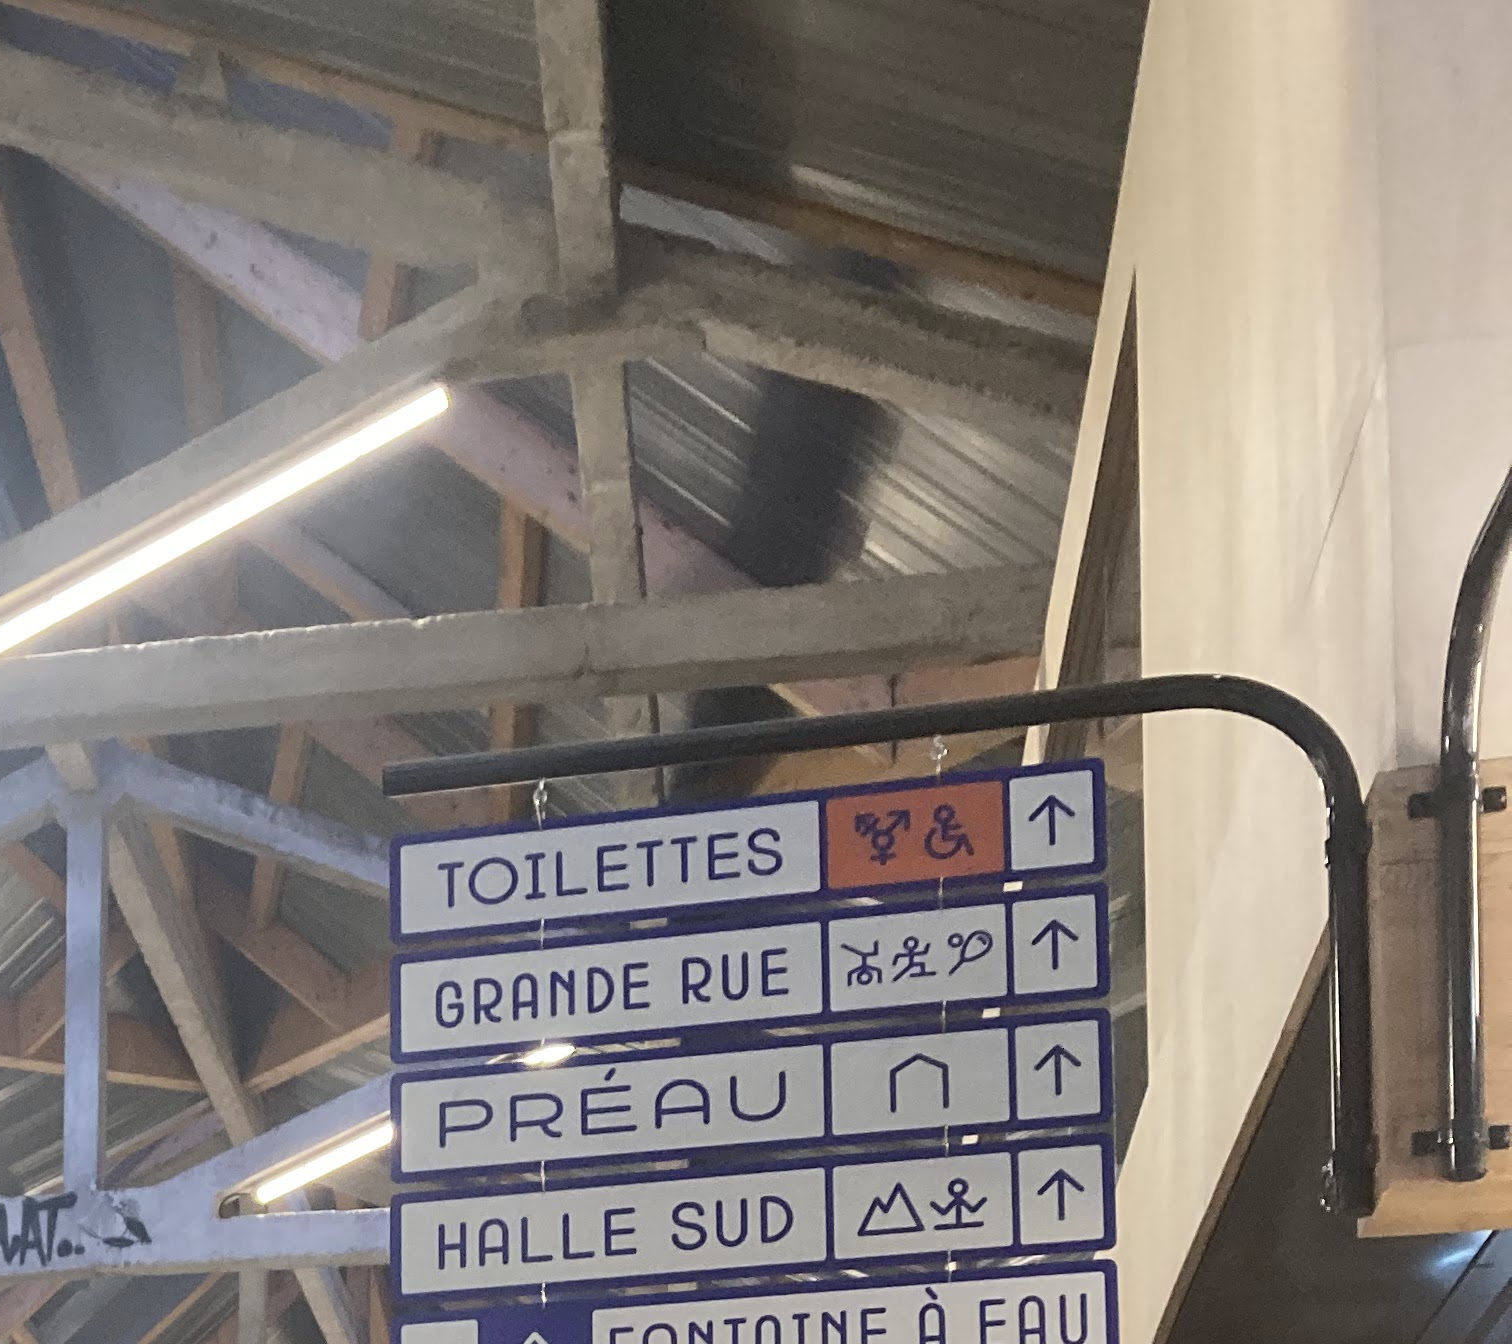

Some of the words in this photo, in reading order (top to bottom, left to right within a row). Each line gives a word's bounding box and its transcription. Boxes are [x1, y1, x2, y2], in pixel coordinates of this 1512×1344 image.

[437, 828, 784, 908] TOILETTES
[435, 961, 651, 1029] GRANDE
[681, 947, 791, 1004] RUE
[437, 1068, 787, 1148] PRÉAU
[437, 1206, 639, 1271] HALLE
[671, 1195, 795, 1250] SUD
